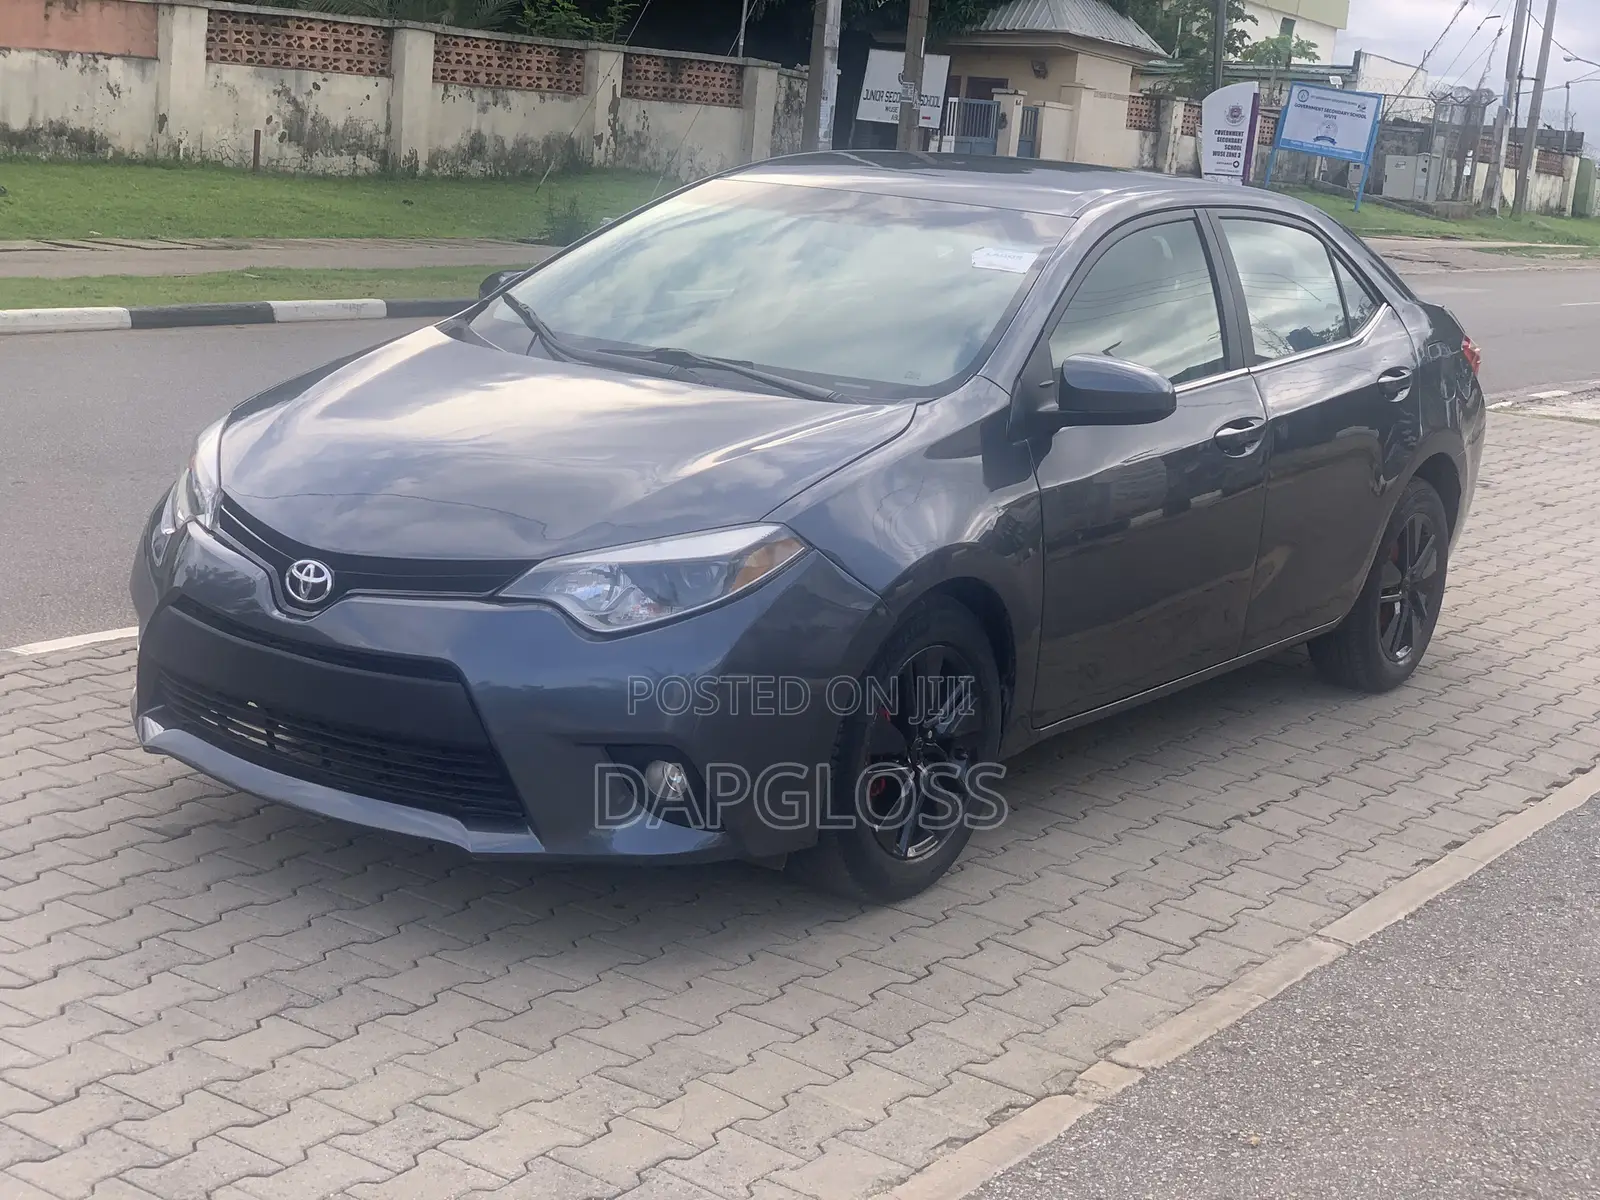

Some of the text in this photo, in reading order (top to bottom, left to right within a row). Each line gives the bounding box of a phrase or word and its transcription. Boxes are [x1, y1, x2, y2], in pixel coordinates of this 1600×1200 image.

[863, 89, 885, 102] JUNIOR
[920, 95, 941, 108] SCHOOL
[1294, 102, 1367, 120] GOVERNMENT SECONDARY SCHOOL
